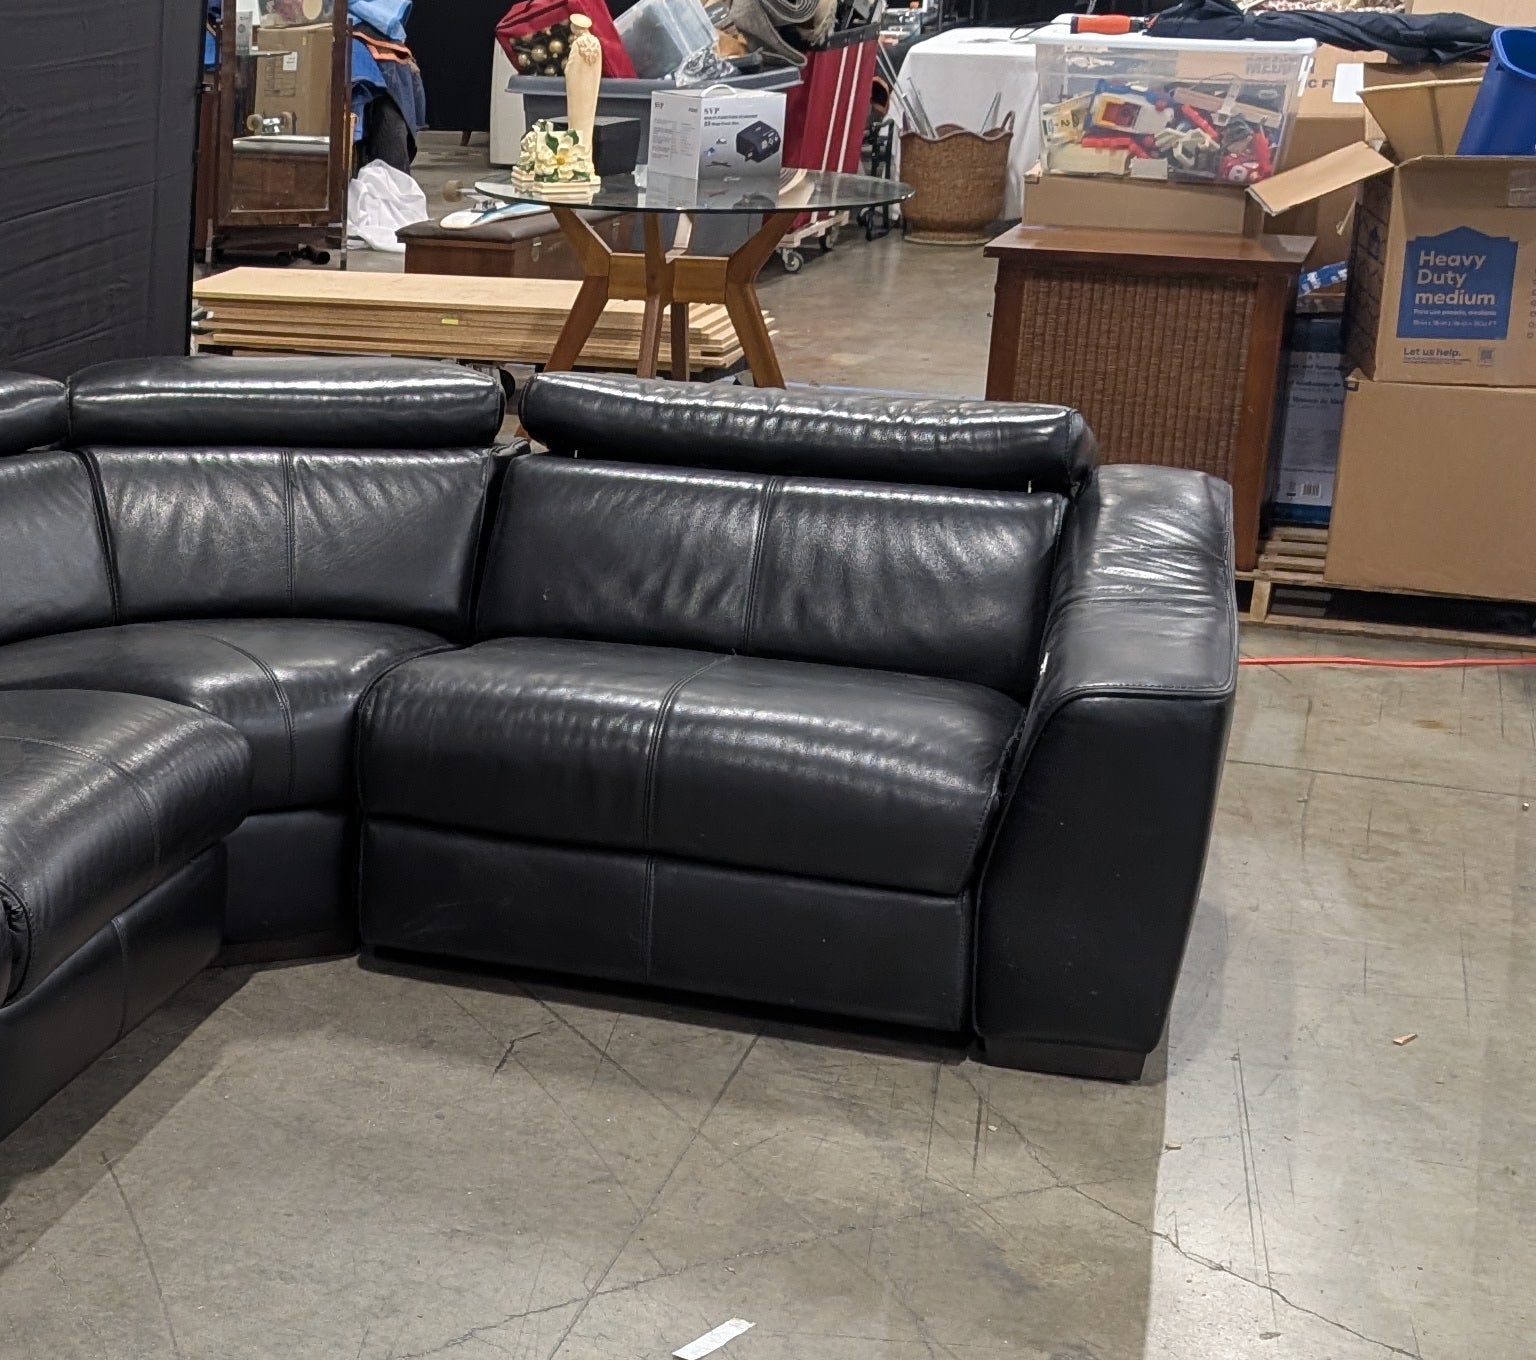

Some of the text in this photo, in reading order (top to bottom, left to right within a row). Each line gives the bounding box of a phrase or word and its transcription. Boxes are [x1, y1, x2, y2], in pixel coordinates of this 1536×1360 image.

[1419, 251, 1486, 269] Heavy
[1417, 269, 1467, 287] Duty
[1415, 290, 1495, 304] medium
[1404, 348, 1461, 357] Let us help.
